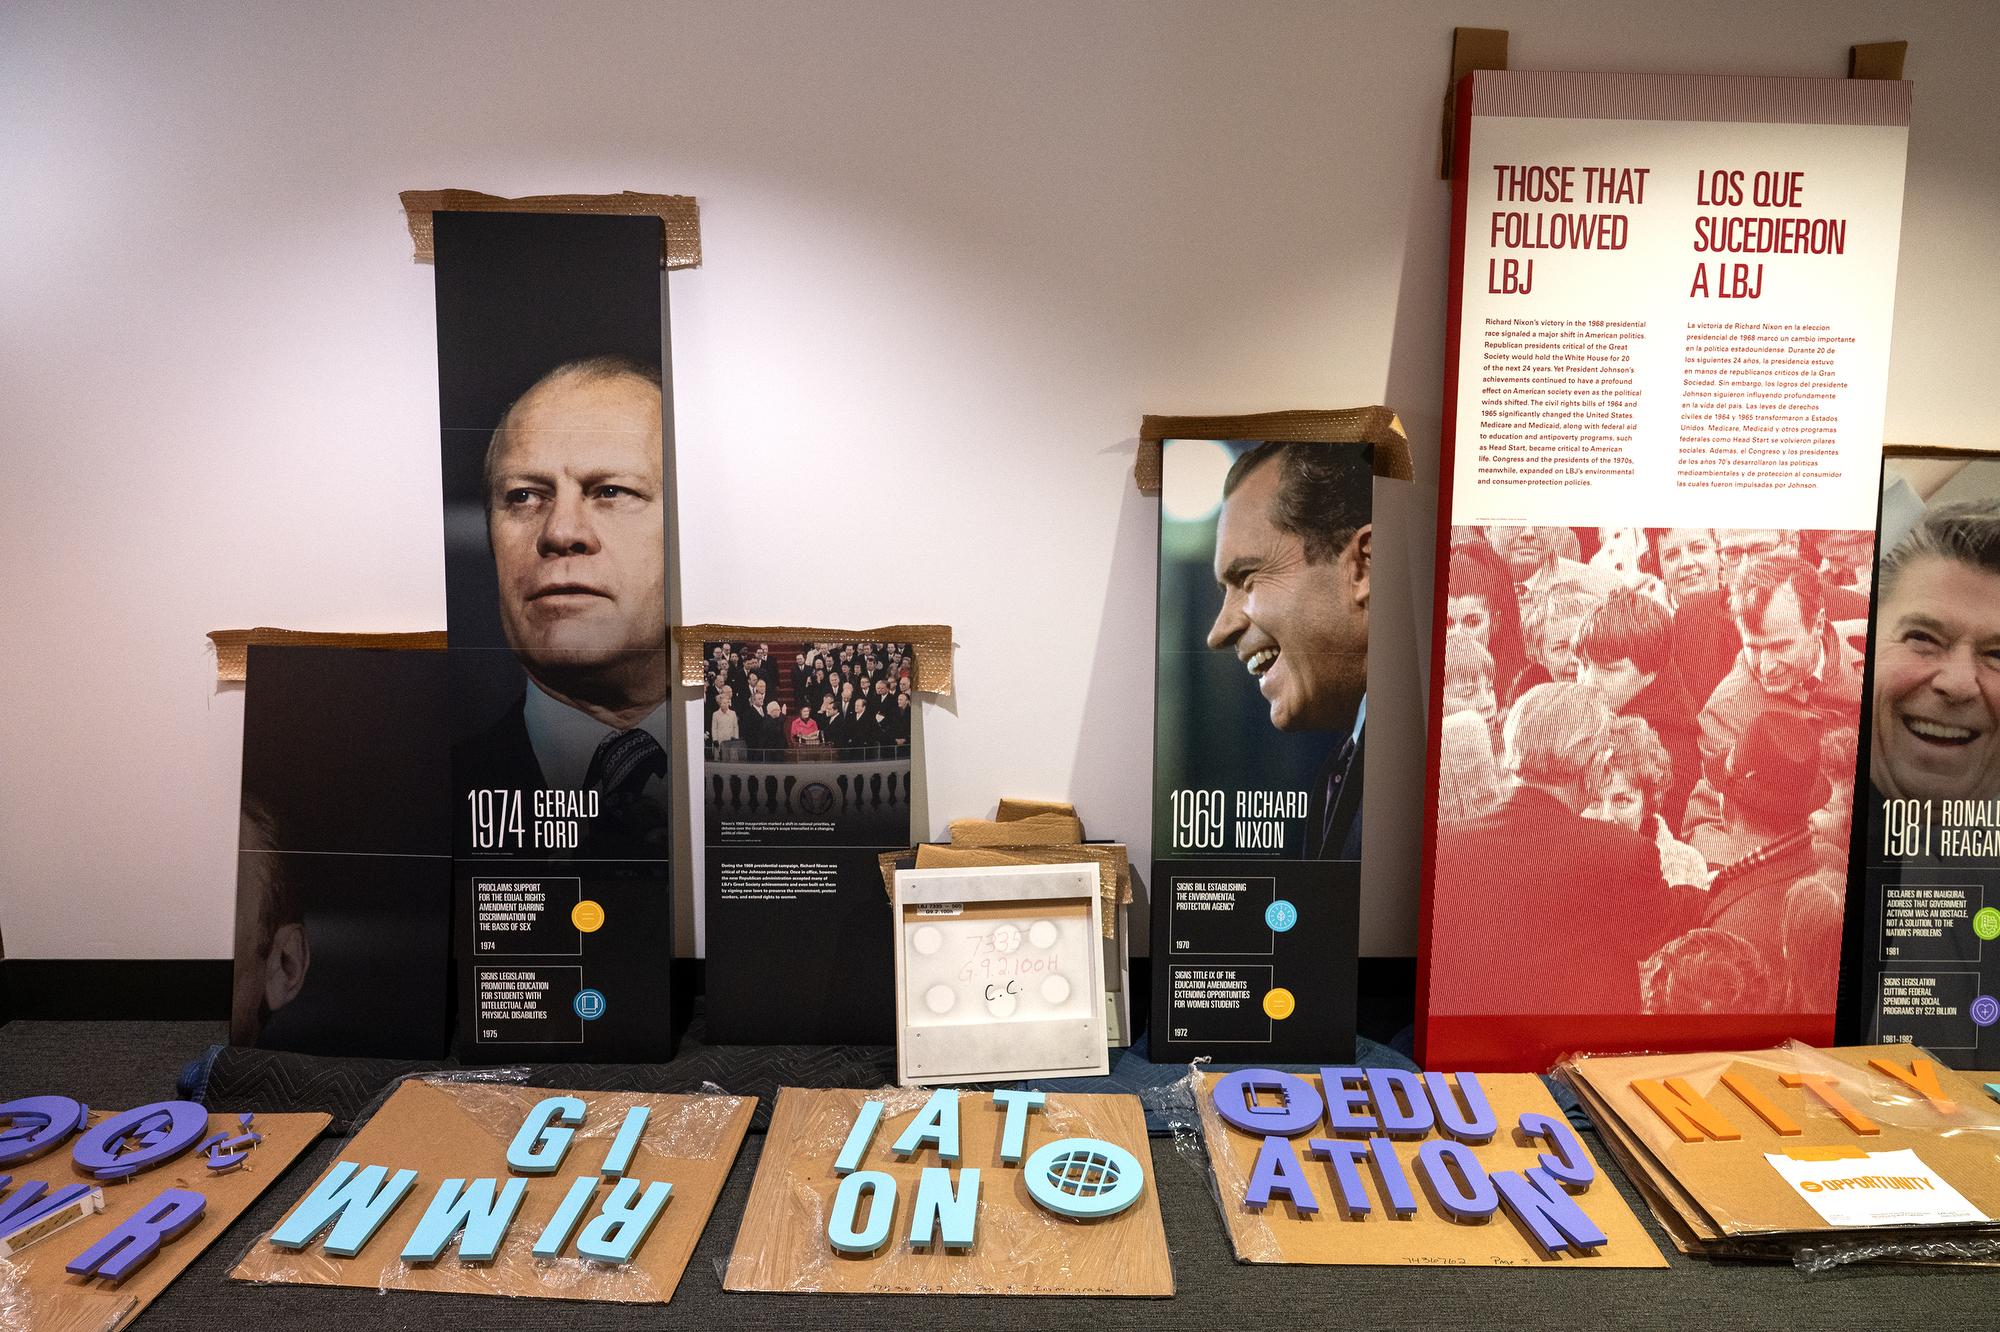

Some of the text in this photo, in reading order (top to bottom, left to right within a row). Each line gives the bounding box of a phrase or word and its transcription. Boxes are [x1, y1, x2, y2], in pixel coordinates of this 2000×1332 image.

[1493, 165, 1650, 204] THOSE THAT
[1697, 170, 1804, 207] LOS QUE
[1491, 212, 1628, 250] FOLLOWED
[1694, 217, 1846, 254] SUCEDIERON
[1488, 259, 1533, 294] LBJ
[1690, 263, 1763, 298] A LBJ
[1541, 319, 1564, 327] victory
[1502, 330, 1530, 338] signaled
[534, 789, 599, 818] GERALD
[1236, 791, 1308, 819] RICHARD
[468, 789, 525, 848] 1974
[1170, 789, 1224, 848] 1969
[1883, 799, 1931, 856] 1981
[534, 820, 578, 848] FORD
[1235, 821, 1284, 848] NIXON
[1177, 883, 1246, 891] SIGNS BILL ESTABLISHING
[479, 893, 545, 901] FOR THE EQUAL RIGHTS
[1177, 893, 1235, 901] THE ENVIRONMENTAL
[1887, 890, 1965, 898] DECLARES IN HIS INAUGURAL
[479, 903, 544, 911] AMENDMENT BARRING
[1887, 900, 1967, 908] ADDRESS THAT GOVERNMENT
[480, 913, 536, 921] DISCRIMINATION ON
[1886, 919, 1897, 927] NOT
[1899, 919, 1903, 927] A
[1176, 941, 1189, 949] 1970
[481, 972, 535, 980] SIGNS LEGISLATION
[1175, 971, 1236, 979] SIGNS TITLE IX OF THE
[481, 982, 549, 990] PROMOTING EDUCATION
[1175, 981, 1247, 989] EDUCATION AMENDMENTS
[1884, 978, 1936, 986] SIGNS LEGISLATION
[1175, 1000, 1240, 1008] FOR WOMEN STUDENTS
[482, 1011, 547, 1019] PHYSICAL DISABILITIES
[1883, 1007, 1914, 1015] PROGRAMS
[1925, 1007, 1935, 1015] $22
[483, 1030, 497, 1038] 1975
[1319, 1067, 1498, 1140] EDU
[1821, 1175, 1935, 1191] OPPORTUNITY
[828, 1167, 980, 1252] ON
